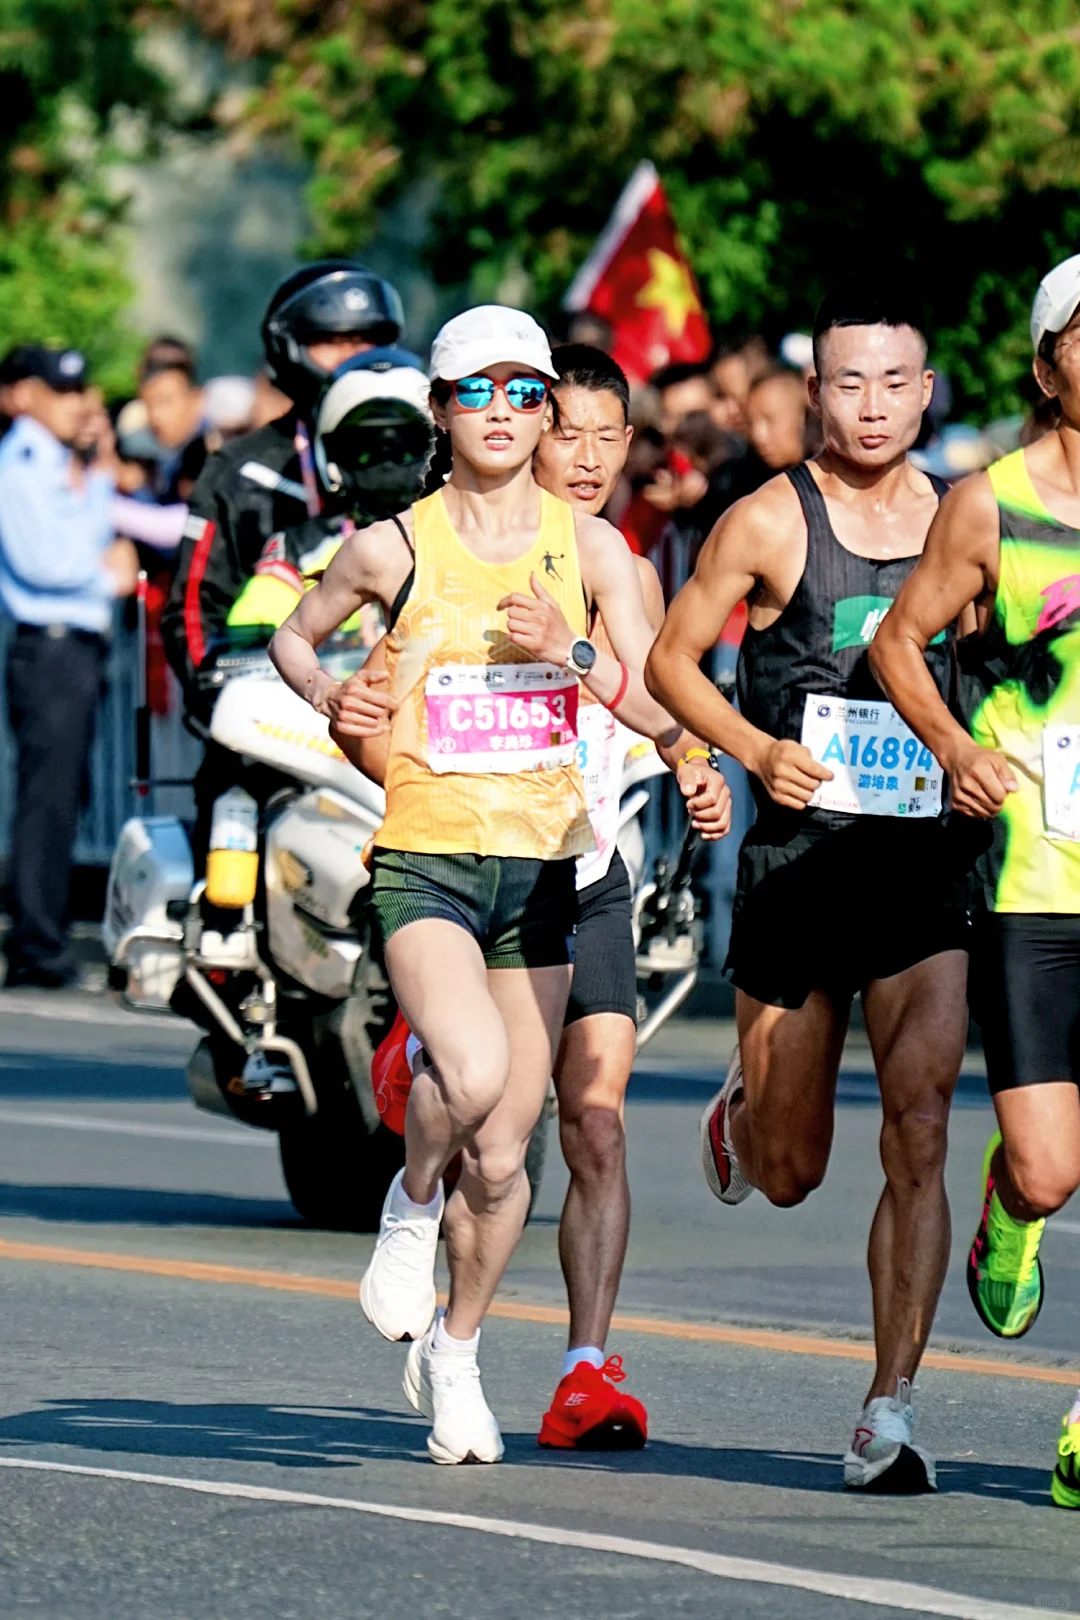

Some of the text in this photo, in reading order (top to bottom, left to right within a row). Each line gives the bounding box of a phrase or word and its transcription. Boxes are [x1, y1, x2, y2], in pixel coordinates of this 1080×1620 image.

[449, 694, 566, 731] C51653
[836, 706, 880, 720] 兰州银行
[821, 733, 933, 772] A16894
